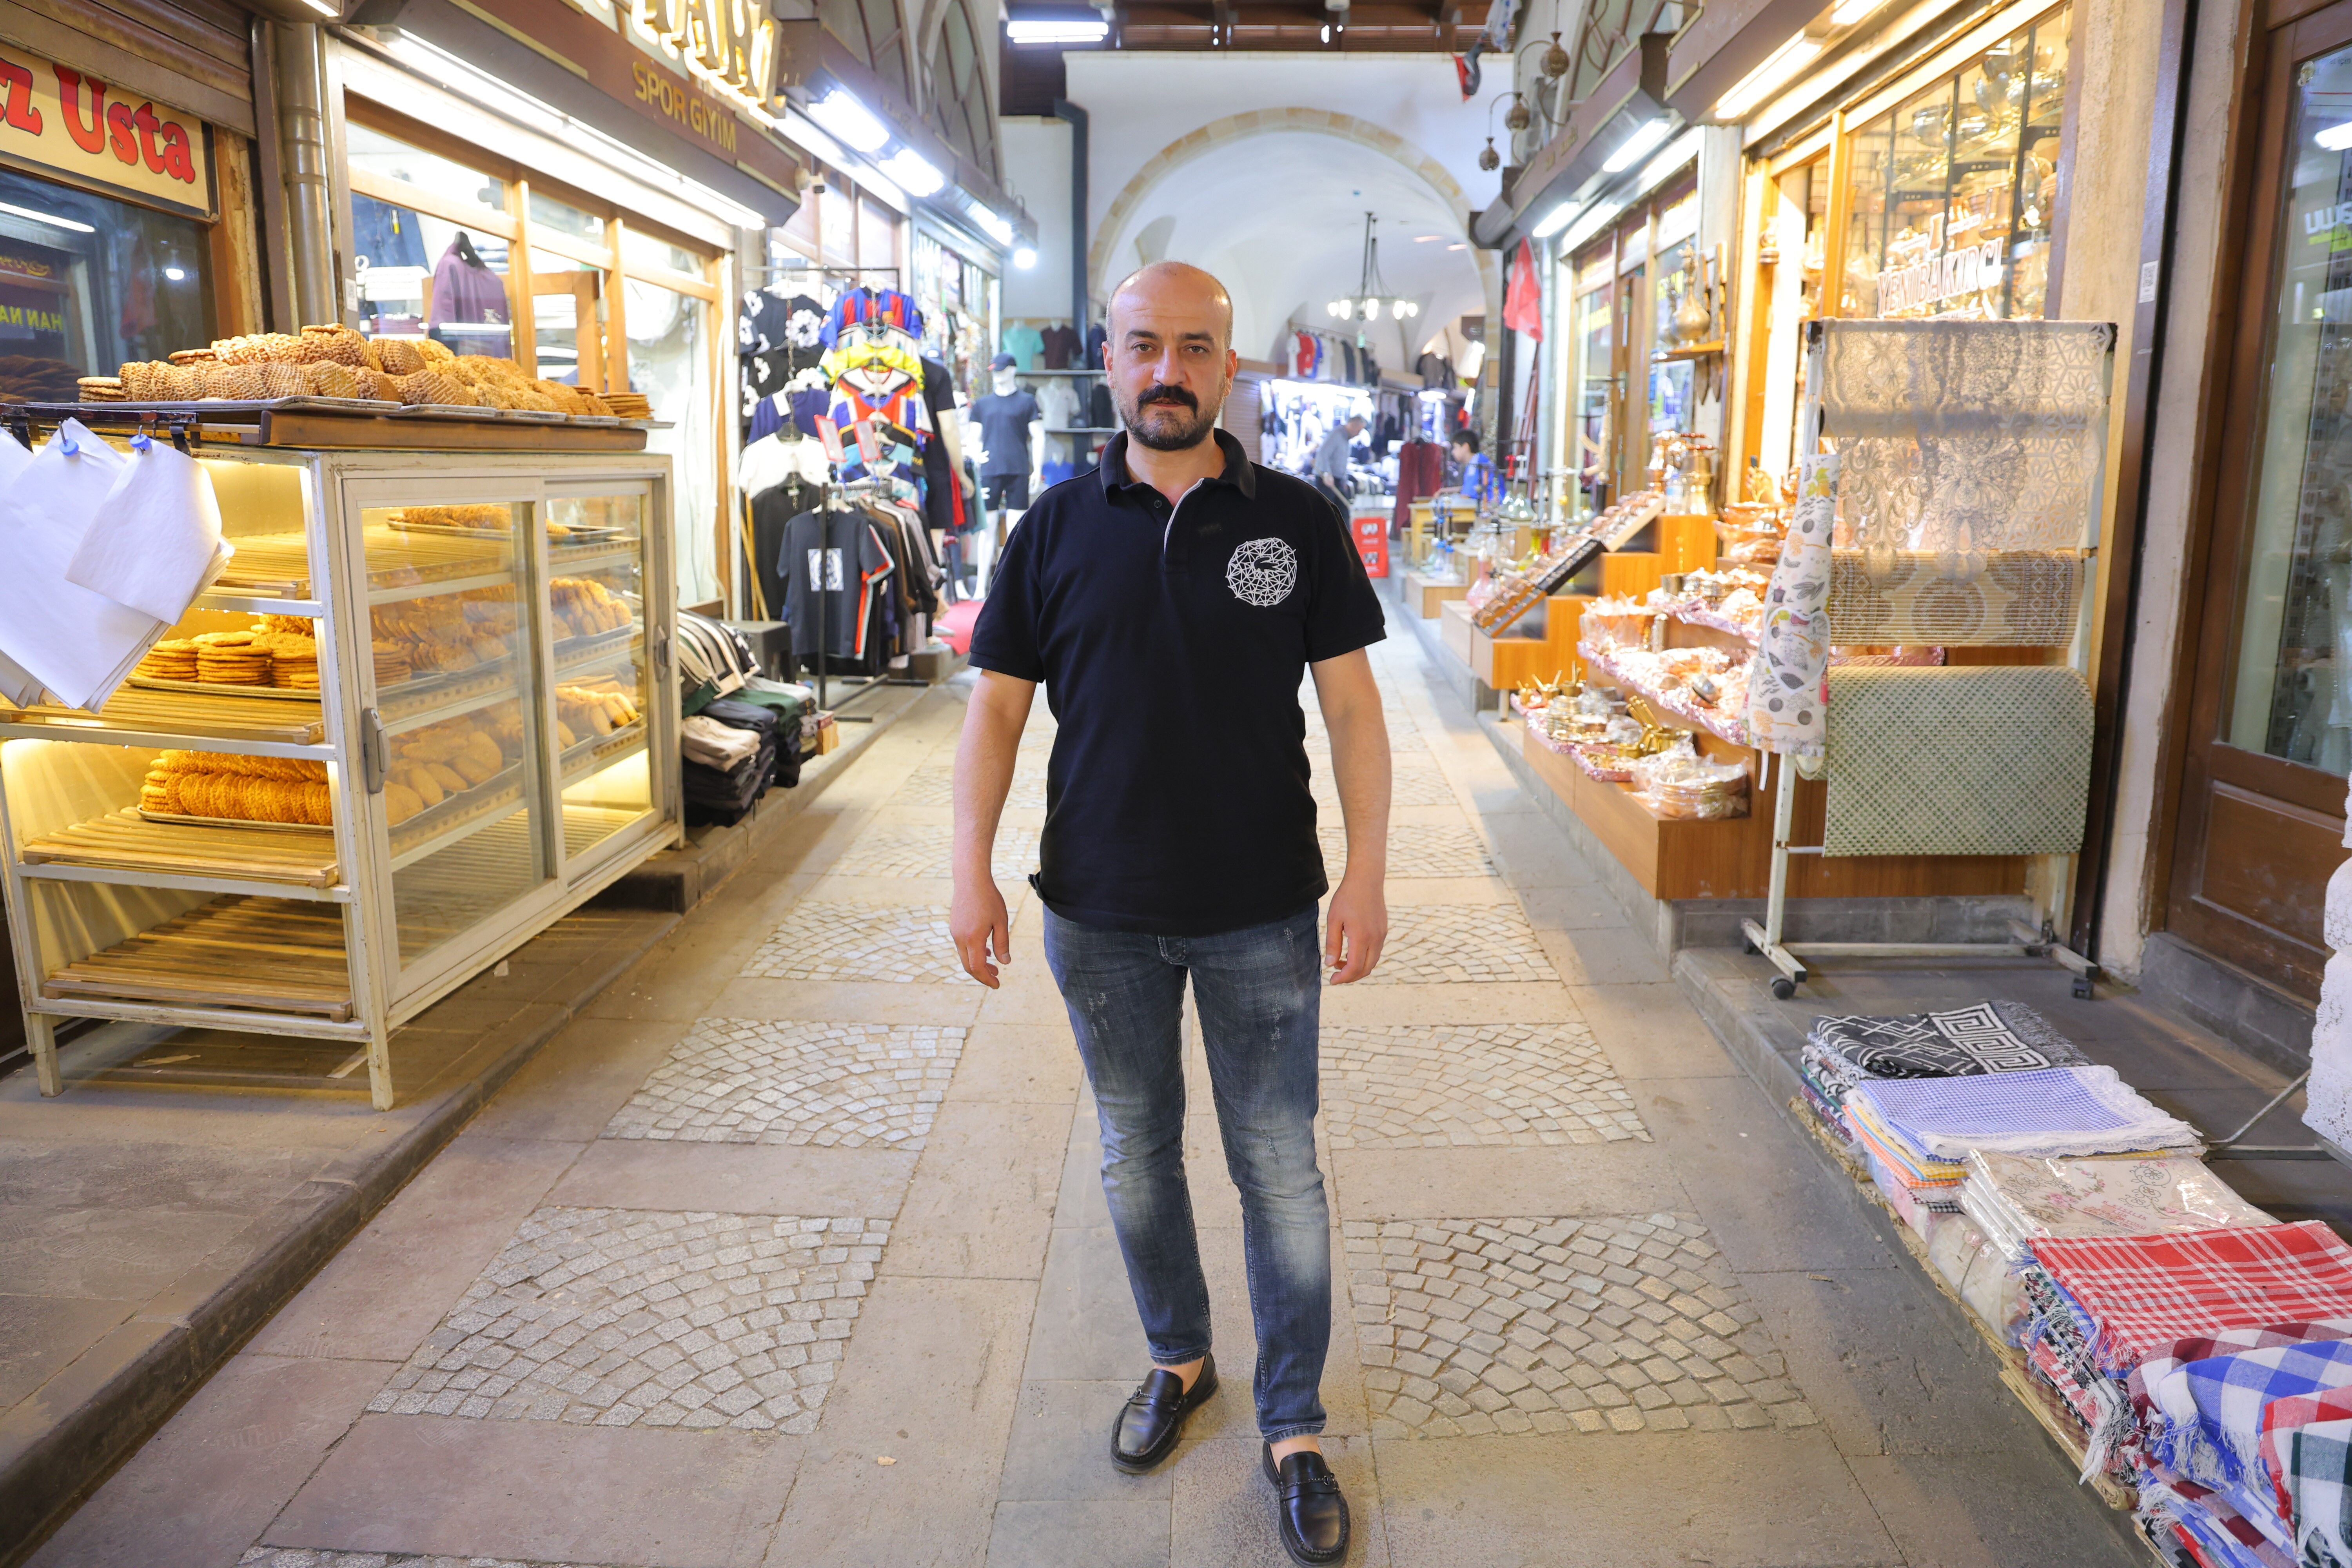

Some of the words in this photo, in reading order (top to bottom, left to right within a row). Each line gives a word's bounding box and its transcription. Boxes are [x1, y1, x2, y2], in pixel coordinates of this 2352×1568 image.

[53, 63, 196, 183] Usta
[632, 61, 686, 126] SPOR
[690, 96, 737, 153] GİYİM
